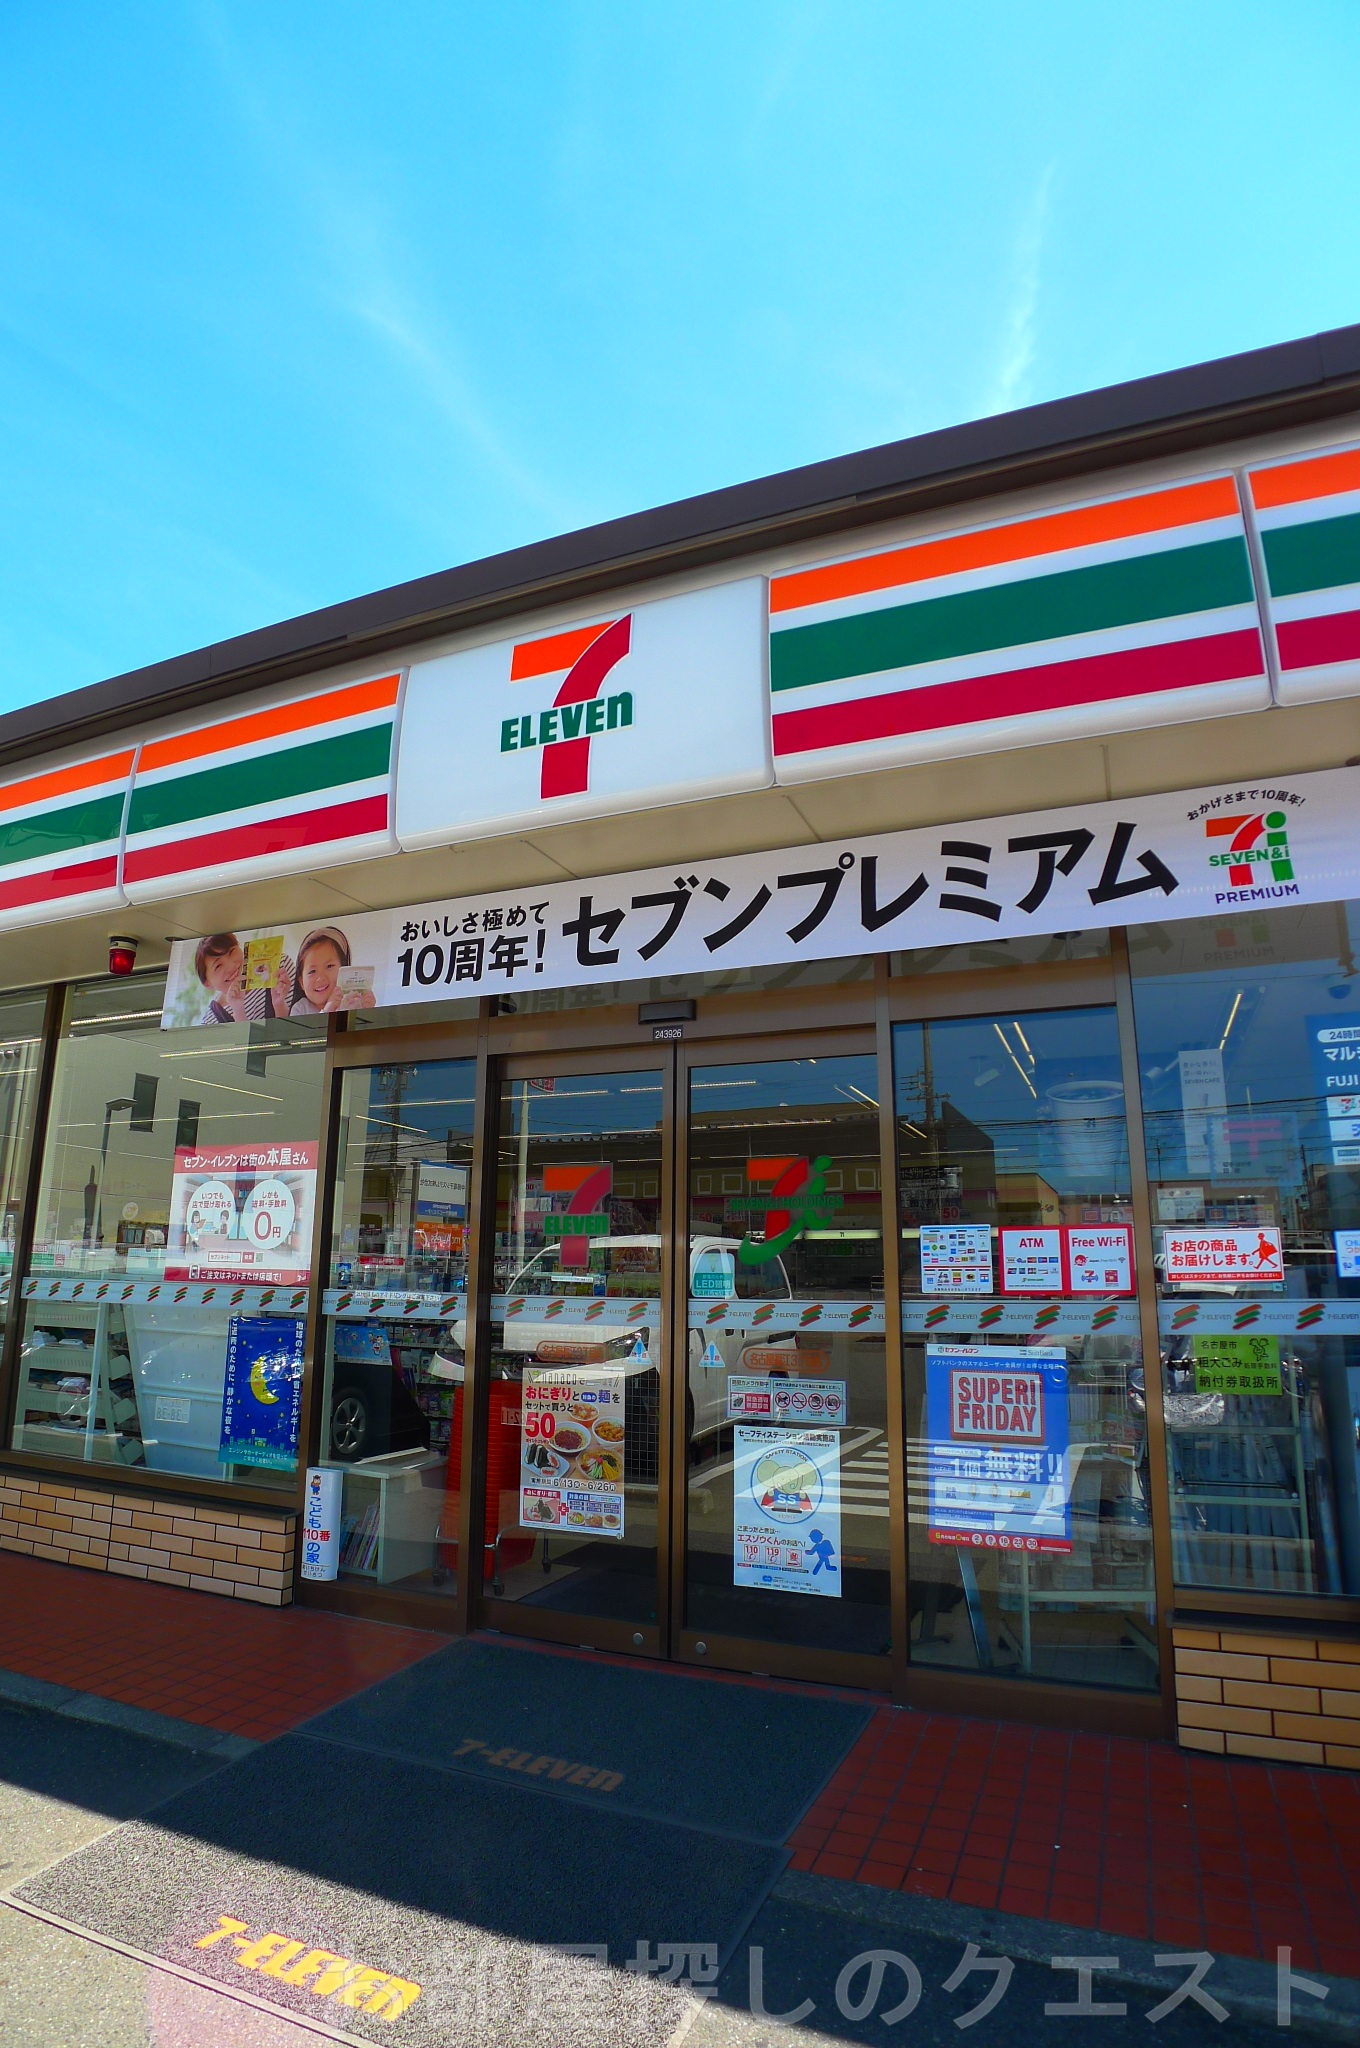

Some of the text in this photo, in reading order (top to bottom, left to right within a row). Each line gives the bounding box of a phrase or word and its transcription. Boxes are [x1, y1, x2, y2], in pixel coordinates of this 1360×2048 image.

[562, 821, 1179, 967] セブンプレミアム
[1215, 883, 1300, 904] PREMIUM
[401, 902, 550, 942] おいしさ極めて
[397, 927, 547, 988] 10周年!
[654, 1028, 682, 1039] 243926
[201, 1192, 224, 1200] いつでも
[1019, 1237, 1044, 1248] ATM
[1071, 1236, 1126, 1247] Free Wi-Fi
[1170, 1239, 1238, 1252] お店の商品
[1171, 1254, 1254, 1267] お届けします。
[1201, 1340, 1238, 1350] 名古屋市
[1198, 1356, 1242, 1368] 粗大ごみ
[1198, 1376, 1279, 1389] 納付券取扱所
[957, 1376, 1036, 1406] SUPER!
[525, 1402, 574, 1412] セットで買うと
[958, 1403, 1036, 1432] FRIDAY
[525, 1411, 556, 1439] 50
[777, 1494, 797, 1505] SS
[745, 1546, 779, 1556] 110 119
